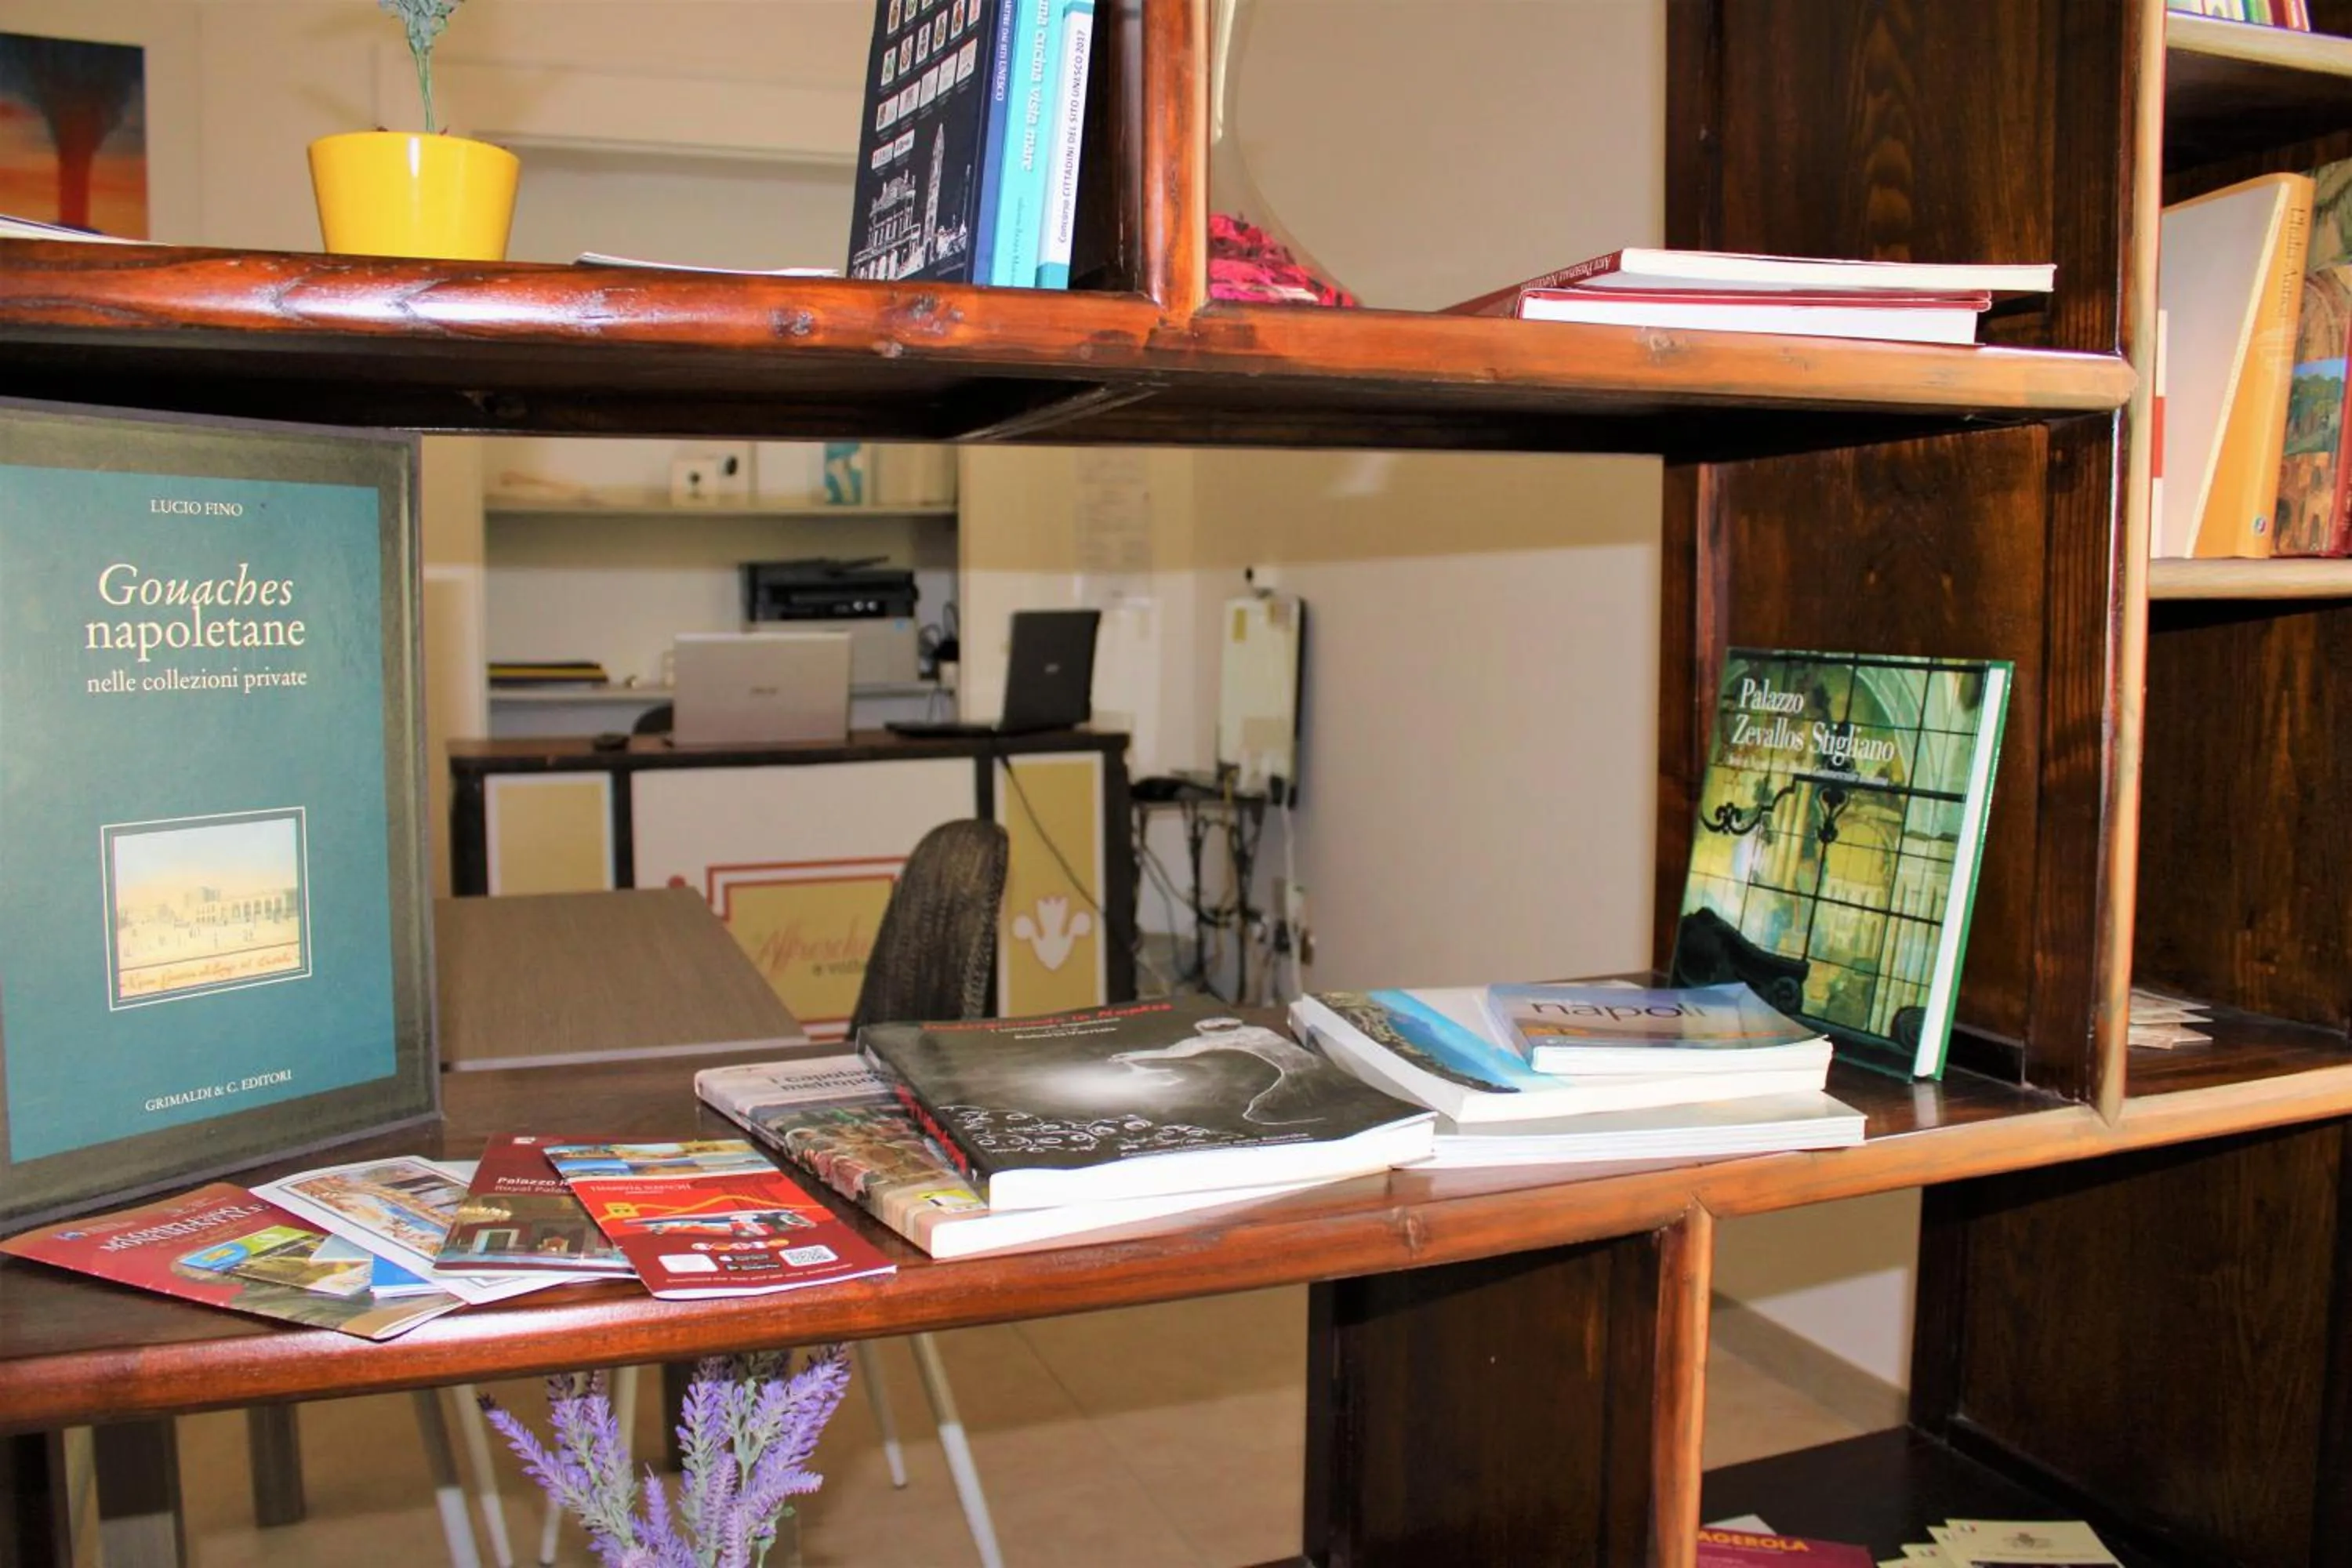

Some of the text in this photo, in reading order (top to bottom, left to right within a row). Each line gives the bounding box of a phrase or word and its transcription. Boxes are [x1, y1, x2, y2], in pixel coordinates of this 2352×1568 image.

[1071, 54, 1083, 98] UNESCO
[1069, 100, 1080, 123] SITO
[1067, 126, 1077, 144] DEL
[1062, 146, 1075, 198] CITTADINI
[150, 499, 244, 517] LUCIO FINO
[98, 562, 294, 606] Gouaches
[84, 604, 306, 663] napoletane
[86, 666, 308, 695] nelle collezioni private
[1739, 677, 1805, 714] Palazzo
[1730, 713, 1895, 767] Zevallos Stigliano
[1530, 1001, 1708, 1022] napoli
[145, 1087, 212, 1112] GRIMALDI
[241, 1069, 292, 1091] EDITORI
[496, 1176, 557, 1187] Palazzo
